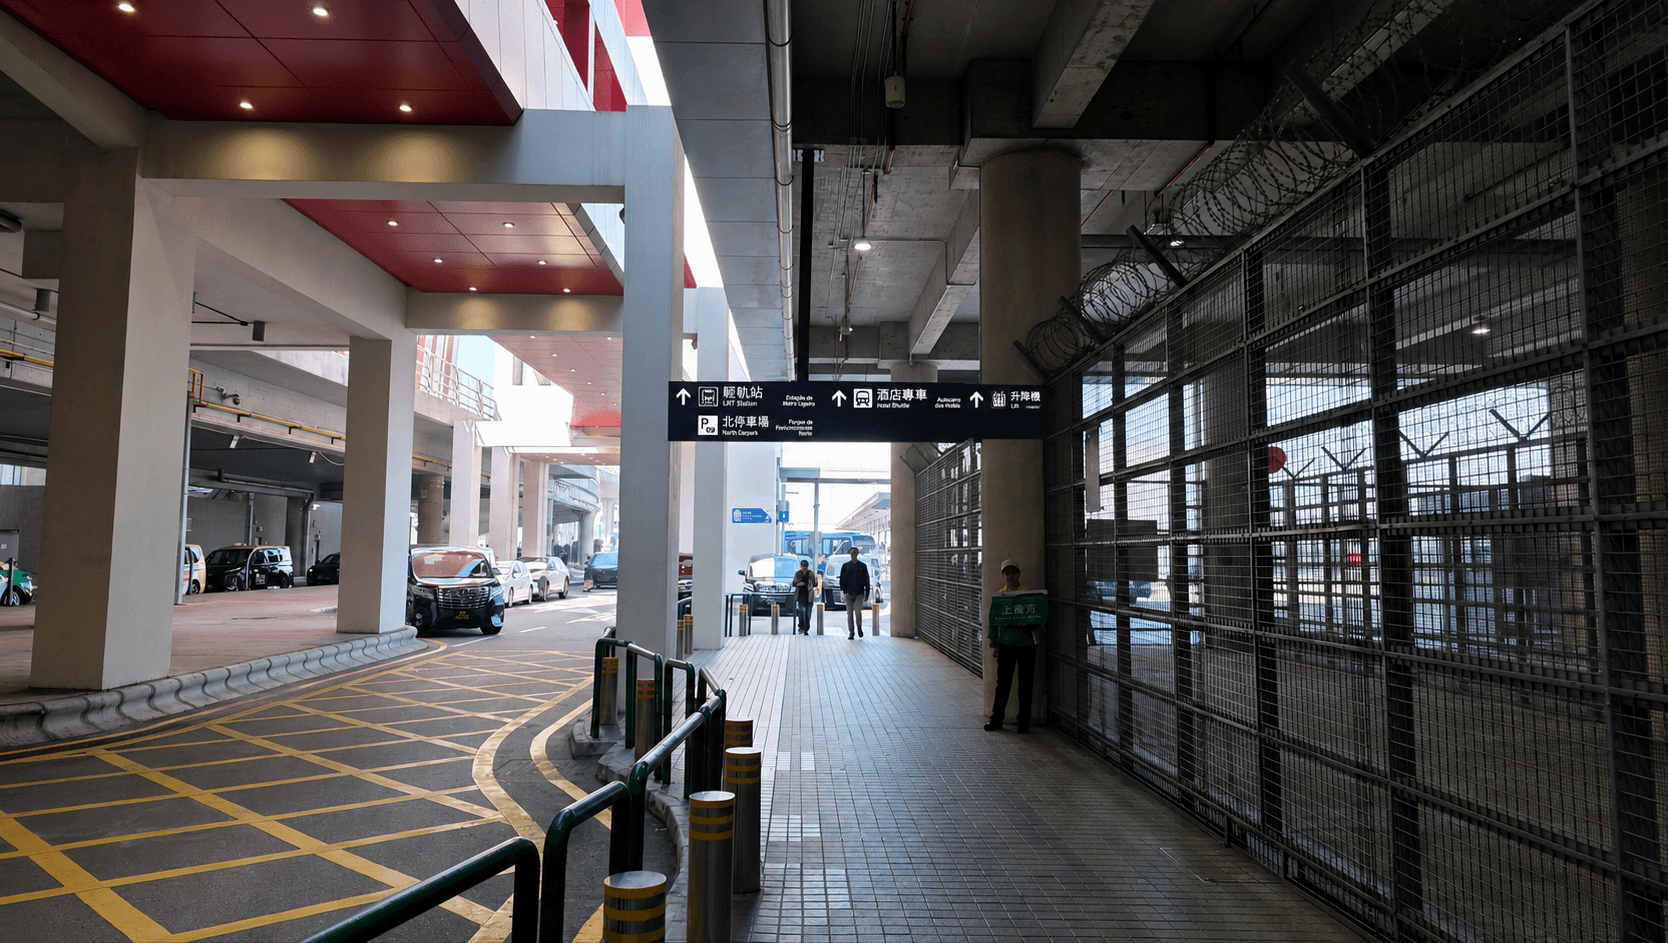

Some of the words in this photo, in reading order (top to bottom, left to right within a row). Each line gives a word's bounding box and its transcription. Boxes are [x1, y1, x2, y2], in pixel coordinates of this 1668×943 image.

[877, 388, 927, 401] 酒店專車
[1010, 390, 1041, 402] 升降機
[701, 417, 709, 430] P
[722, 415, 769, 428] 北停車場
